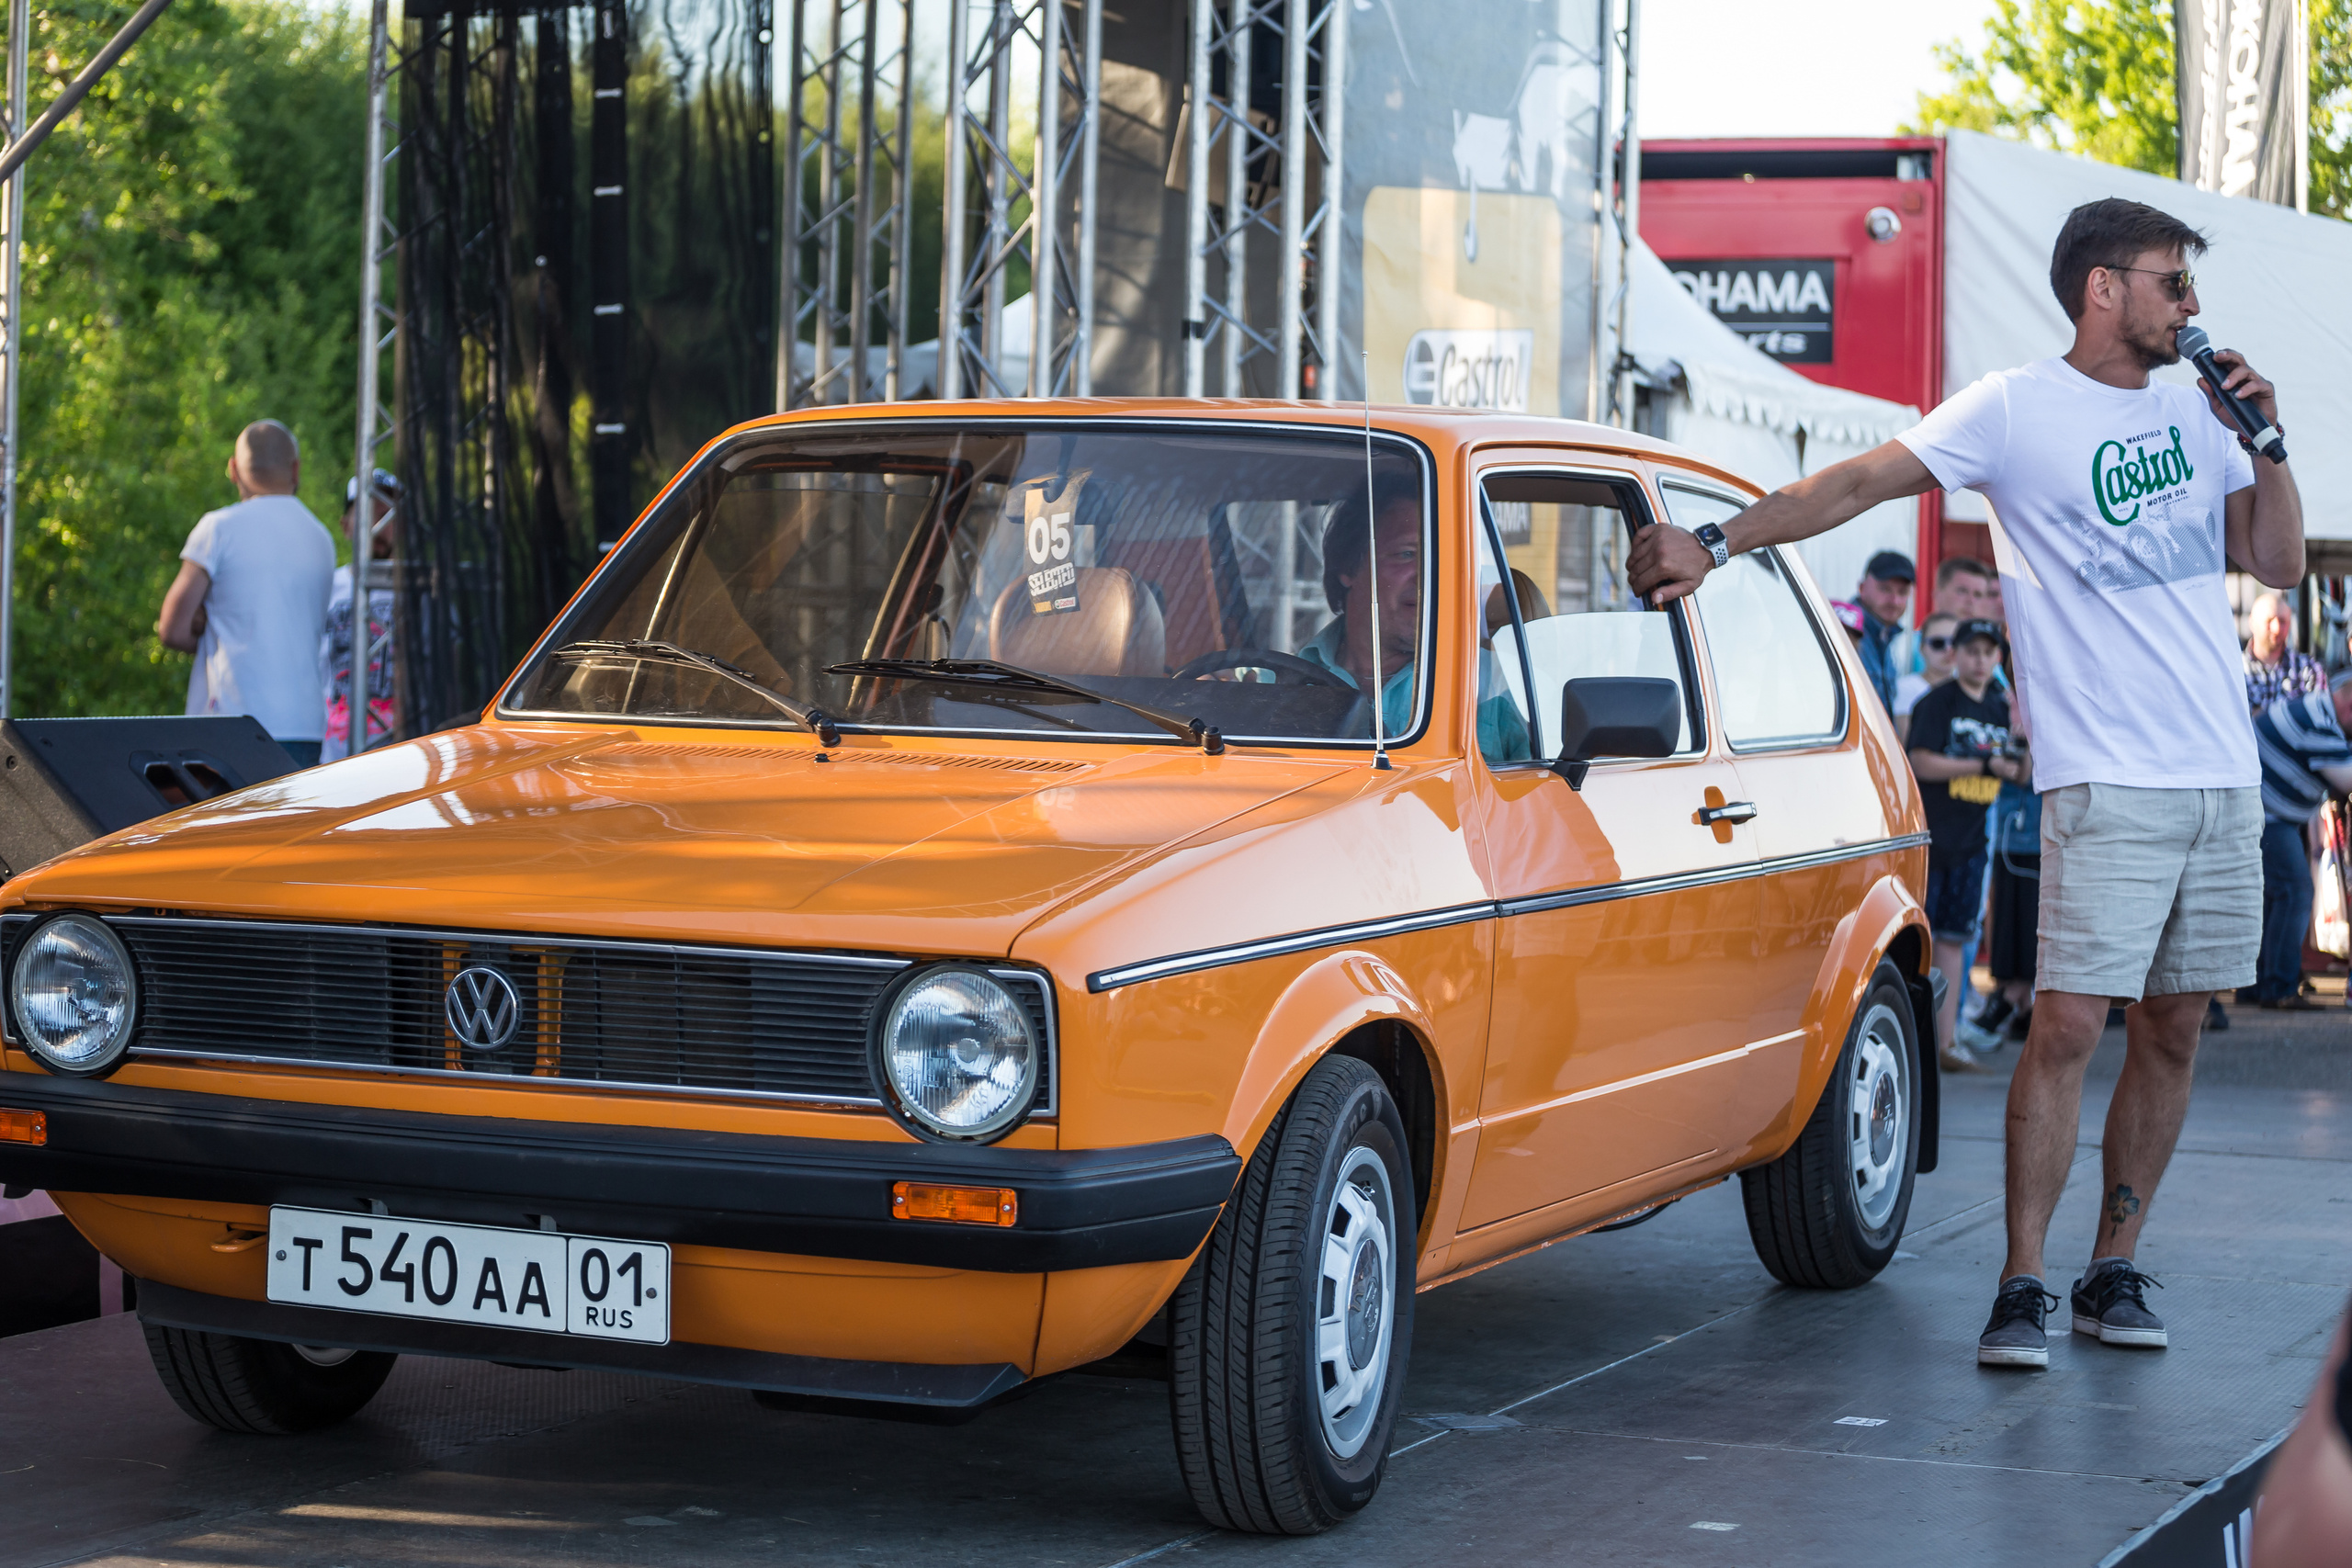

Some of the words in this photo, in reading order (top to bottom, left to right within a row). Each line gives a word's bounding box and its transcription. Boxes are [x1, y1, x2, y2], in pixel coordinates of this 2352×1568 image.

[1439, 343, 1523, 407] Castrol
[2126, 429, 2162, 445] WAKEFIELD
[2092, 425, 2194, 526] Castrol
[2146, 492, 2173, 507] MOTOR
[2175, 488, 2188, 497] OIL
[1028, 512, 1070, 565] 05
[1028, 562, 1075, 596] SELECTED
[580, 1247, 642, 1307] 01
[585, 1306, 633, 1329] RUS
